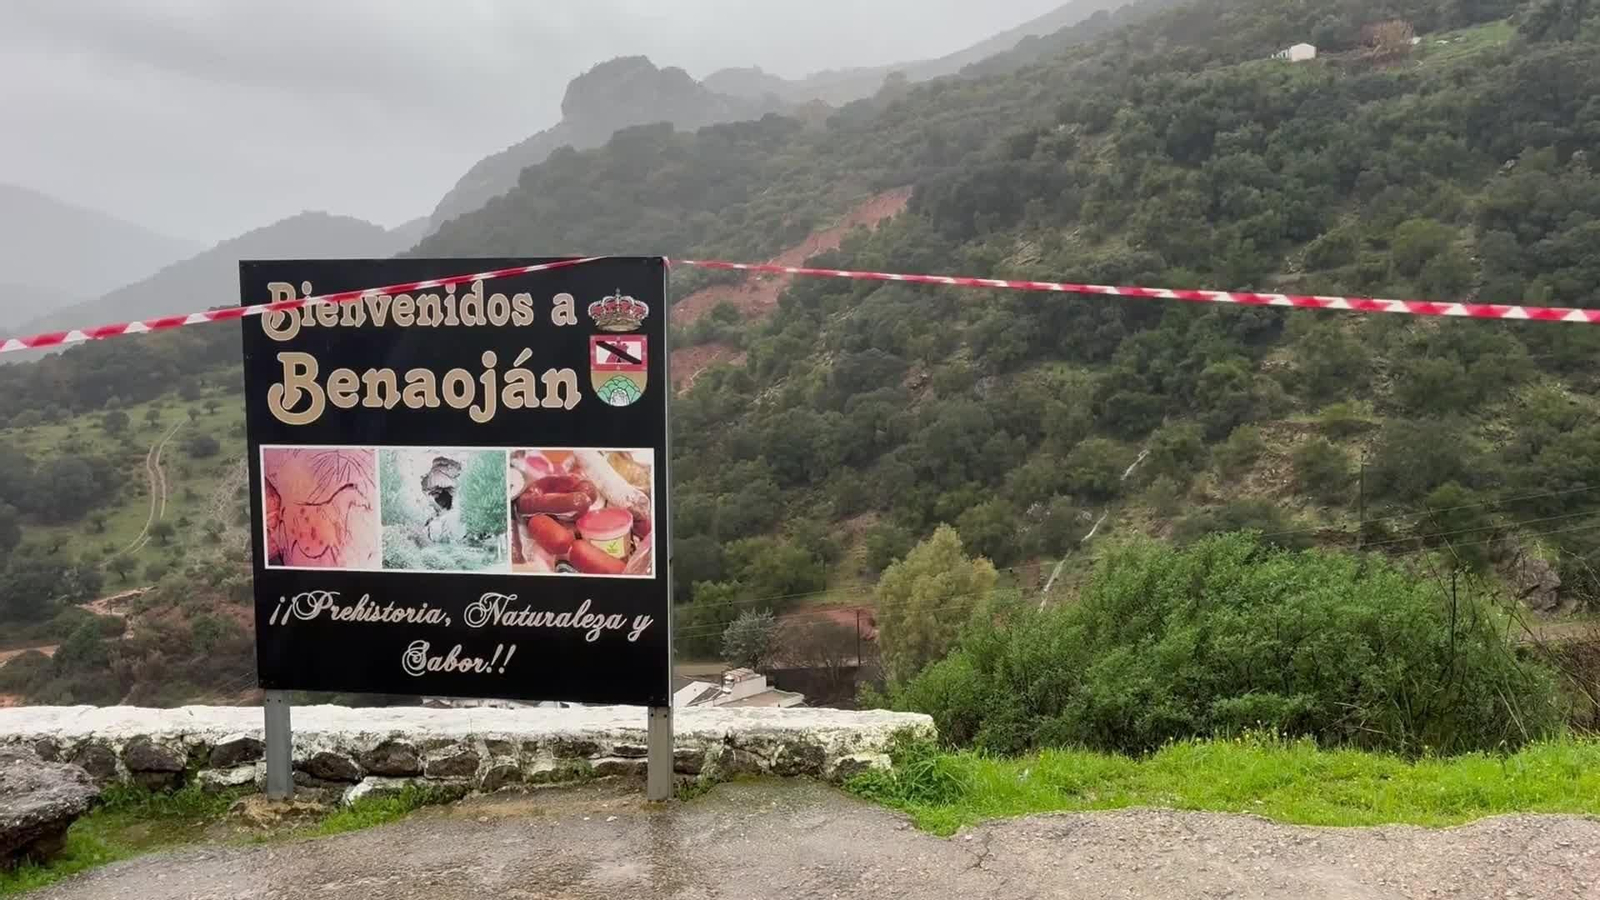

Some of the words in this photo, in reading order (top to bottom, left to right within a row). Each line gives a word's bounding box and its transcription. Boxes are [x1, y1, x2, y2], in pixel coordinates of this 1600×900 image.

[261, 280, 534, 341] Bienvenidos
[551, 293, 578, 326] a
[267, 347, 582, 425] Benaoján
[463, 592, 627, 642] Naturaleza
[627, 616, 653, 642] y
[401, 639, 517, 676] Sabor!!
